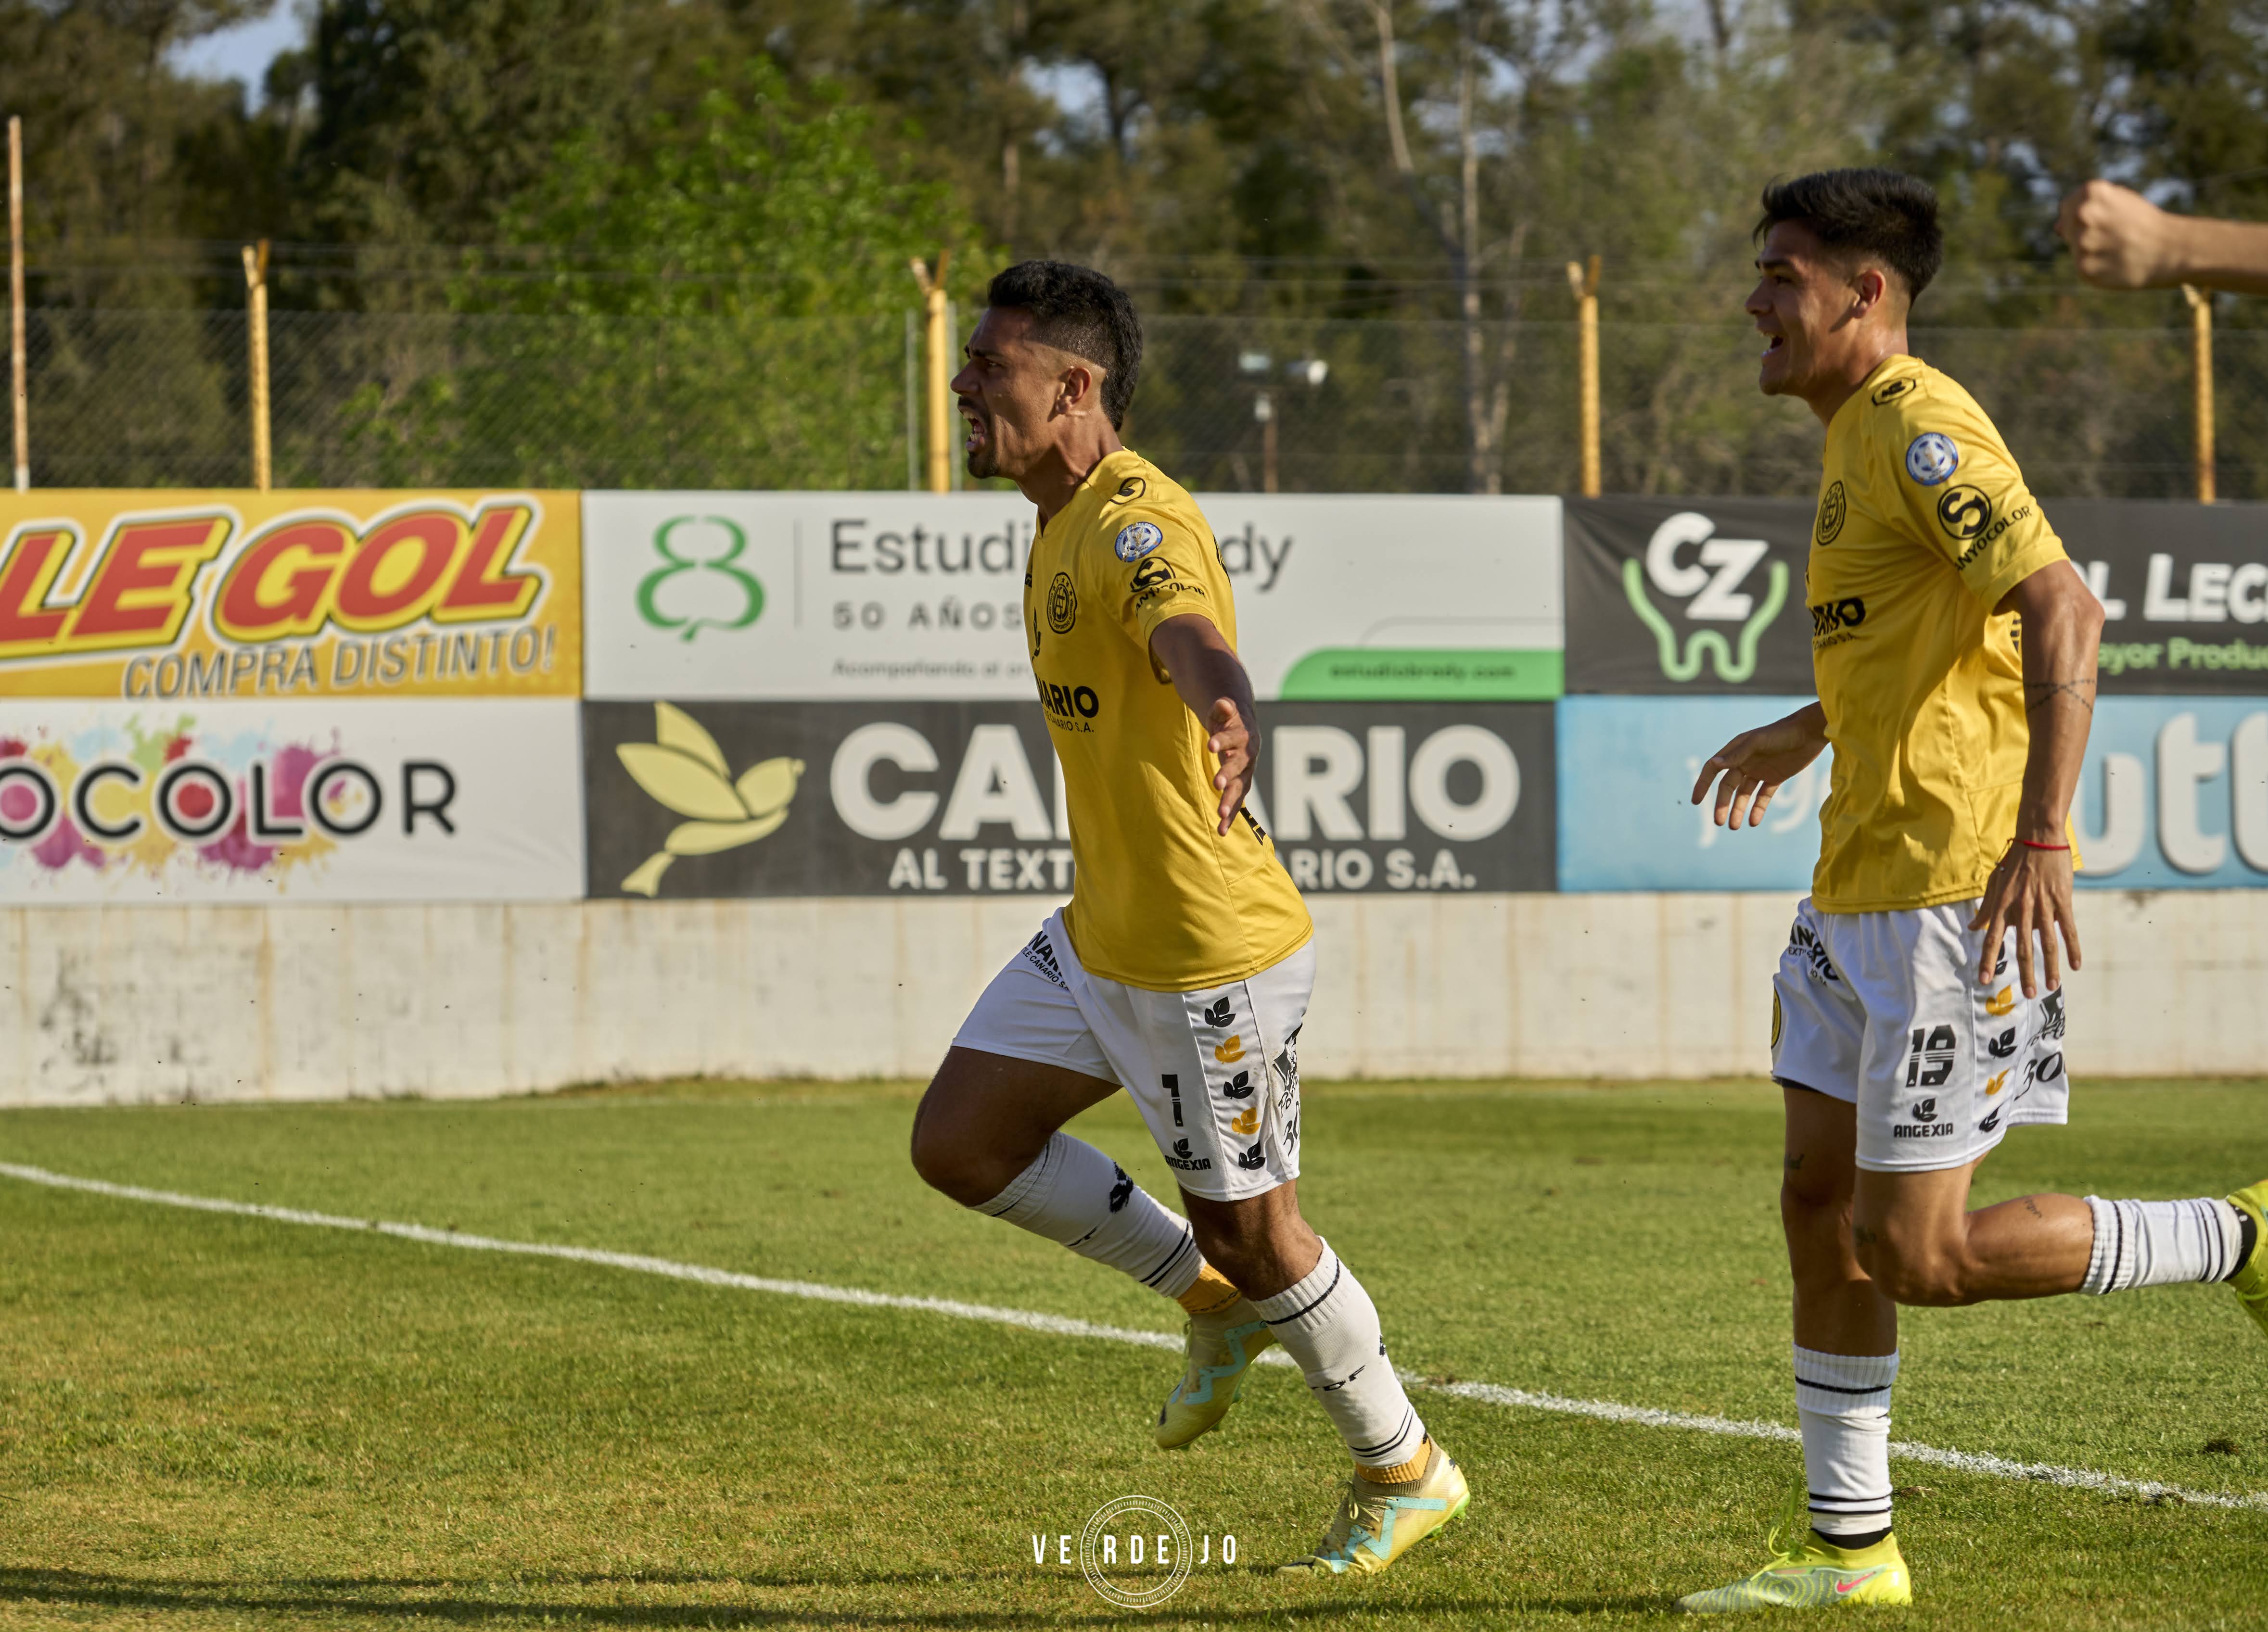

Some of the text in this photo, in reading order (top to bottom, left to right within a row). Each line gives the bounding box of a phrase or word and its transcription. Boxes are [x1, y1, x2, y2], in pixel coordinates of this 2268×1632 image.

[831, 518, 1034, 573] Estudi
[1956, 506, 2033, 571] ANYOCOLOR
[212, 503, 544, 643] GOL
[2143, 553, 2268, 624] LEC
[833, 601, 886, 631] 50
[908, 594, 1023, 632] AÑOS
[123, 625, 557, 701] COMPRA DISTINTO!
[2098, 636, 2268, 676] ayor Produ
[1035, 673, 1099, 718] NARIO
[830, 721, 1521, 842] CARIO
[889, 848, 948, 890] AL
[1385, 848, 1478, 890] S.A.
[1029, 955, 1060, 983] CANARIO
[1893, 1123, 1954, 1139] ANGEXIA
